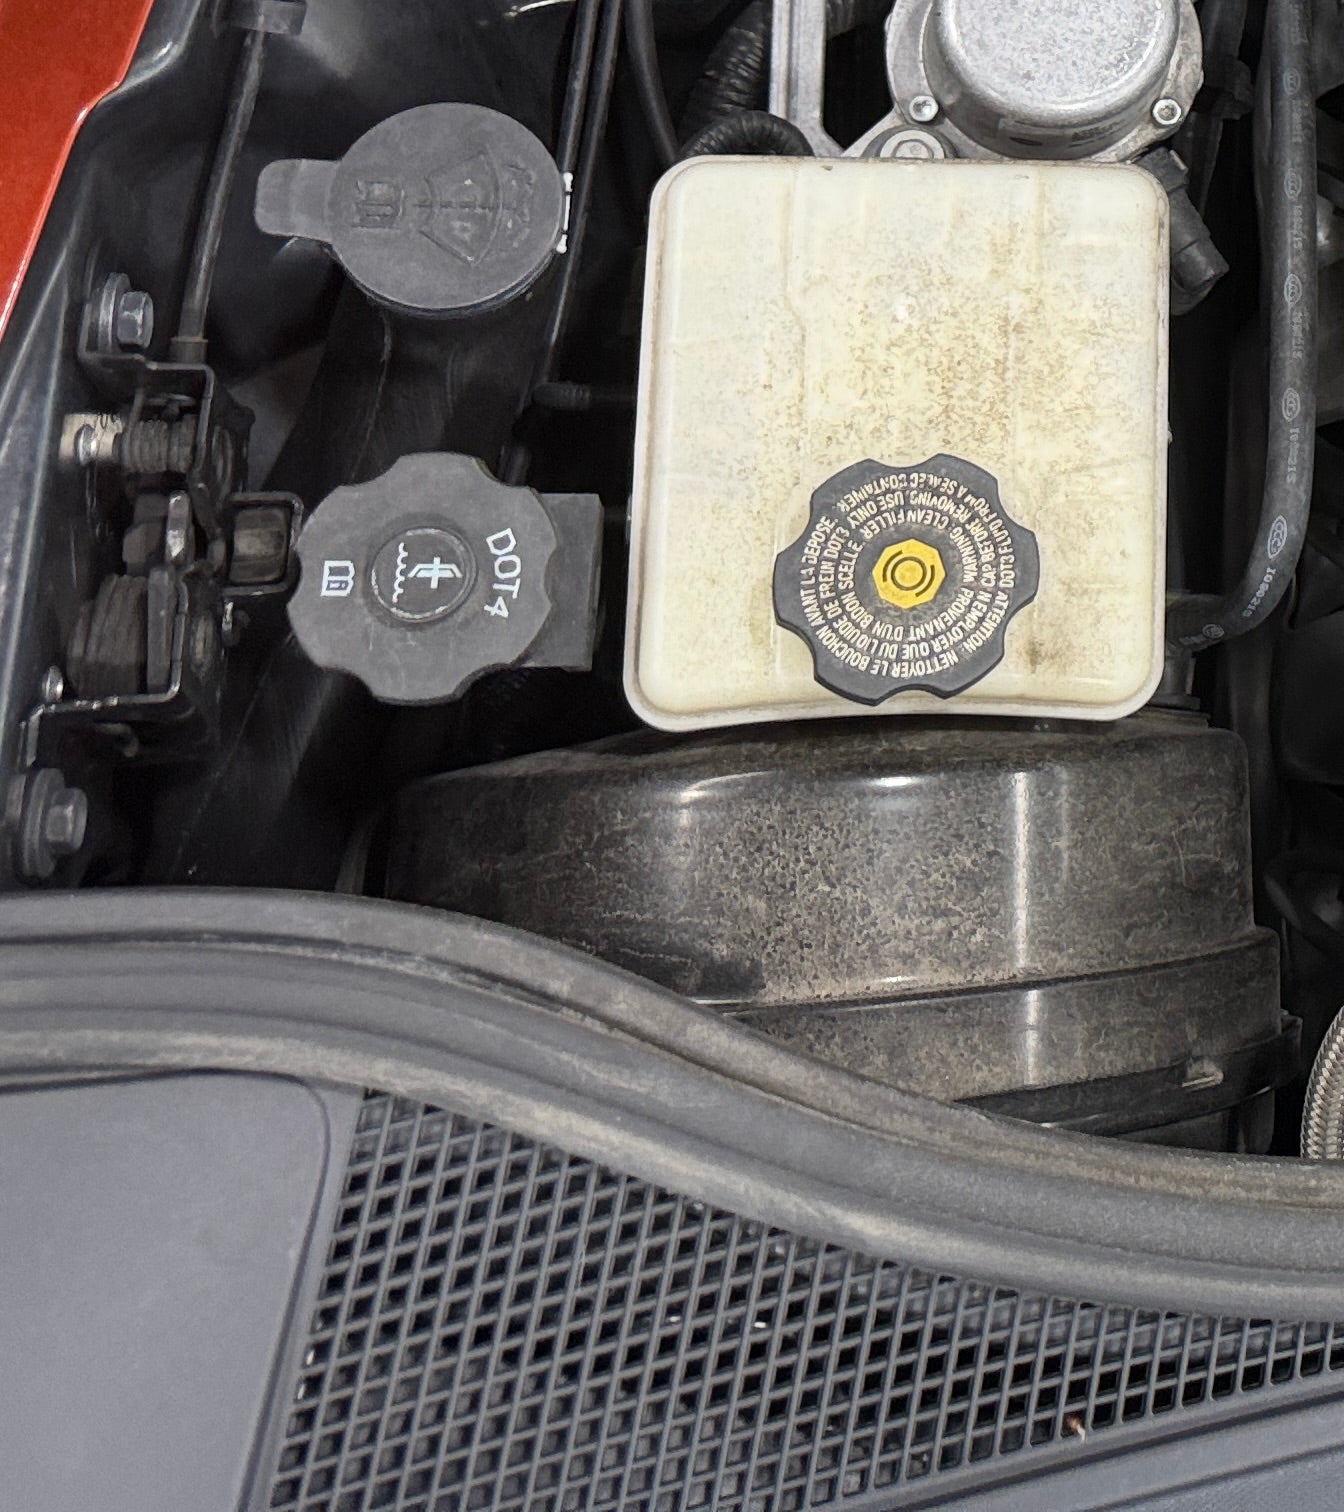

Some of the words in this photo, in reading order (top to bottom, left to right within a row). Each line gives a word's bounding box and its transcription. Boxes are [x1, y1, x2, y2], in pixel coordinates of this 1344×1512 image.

[877, 490, 905, 511] USE
[964, 494, 998, 523] FROM
[847, 501, 878, 530] ONLY
[860, 509, 905, 540] FILLER
[907, 509, 949, 530] CLEAN
[824, 526, 850, 561] DOT3
[965, 518, 996, 563] BEFORE
[800, 566, 815, 585] LA
[817, 561, 837, 599] FREIN
[981, 563, 997, 587] CAP
[800, 588, 824, 628] AVANT
[823, 600, 840, 619] DE
[842, 591, 874, 629] BIDON
[908, 588, 974, 642] PROVENANT
[833, 616, 877, 651] LIQUIDE
[872, 620, 903, 641] D'UN
[816, 626, 870, 670] BOUCHON
[878, 641, 898, 660] DU
[902, 644, 930, 660] QUE
[870, 658, 889, 676] LE
[891, 651, 959, 678] NETTOYER
